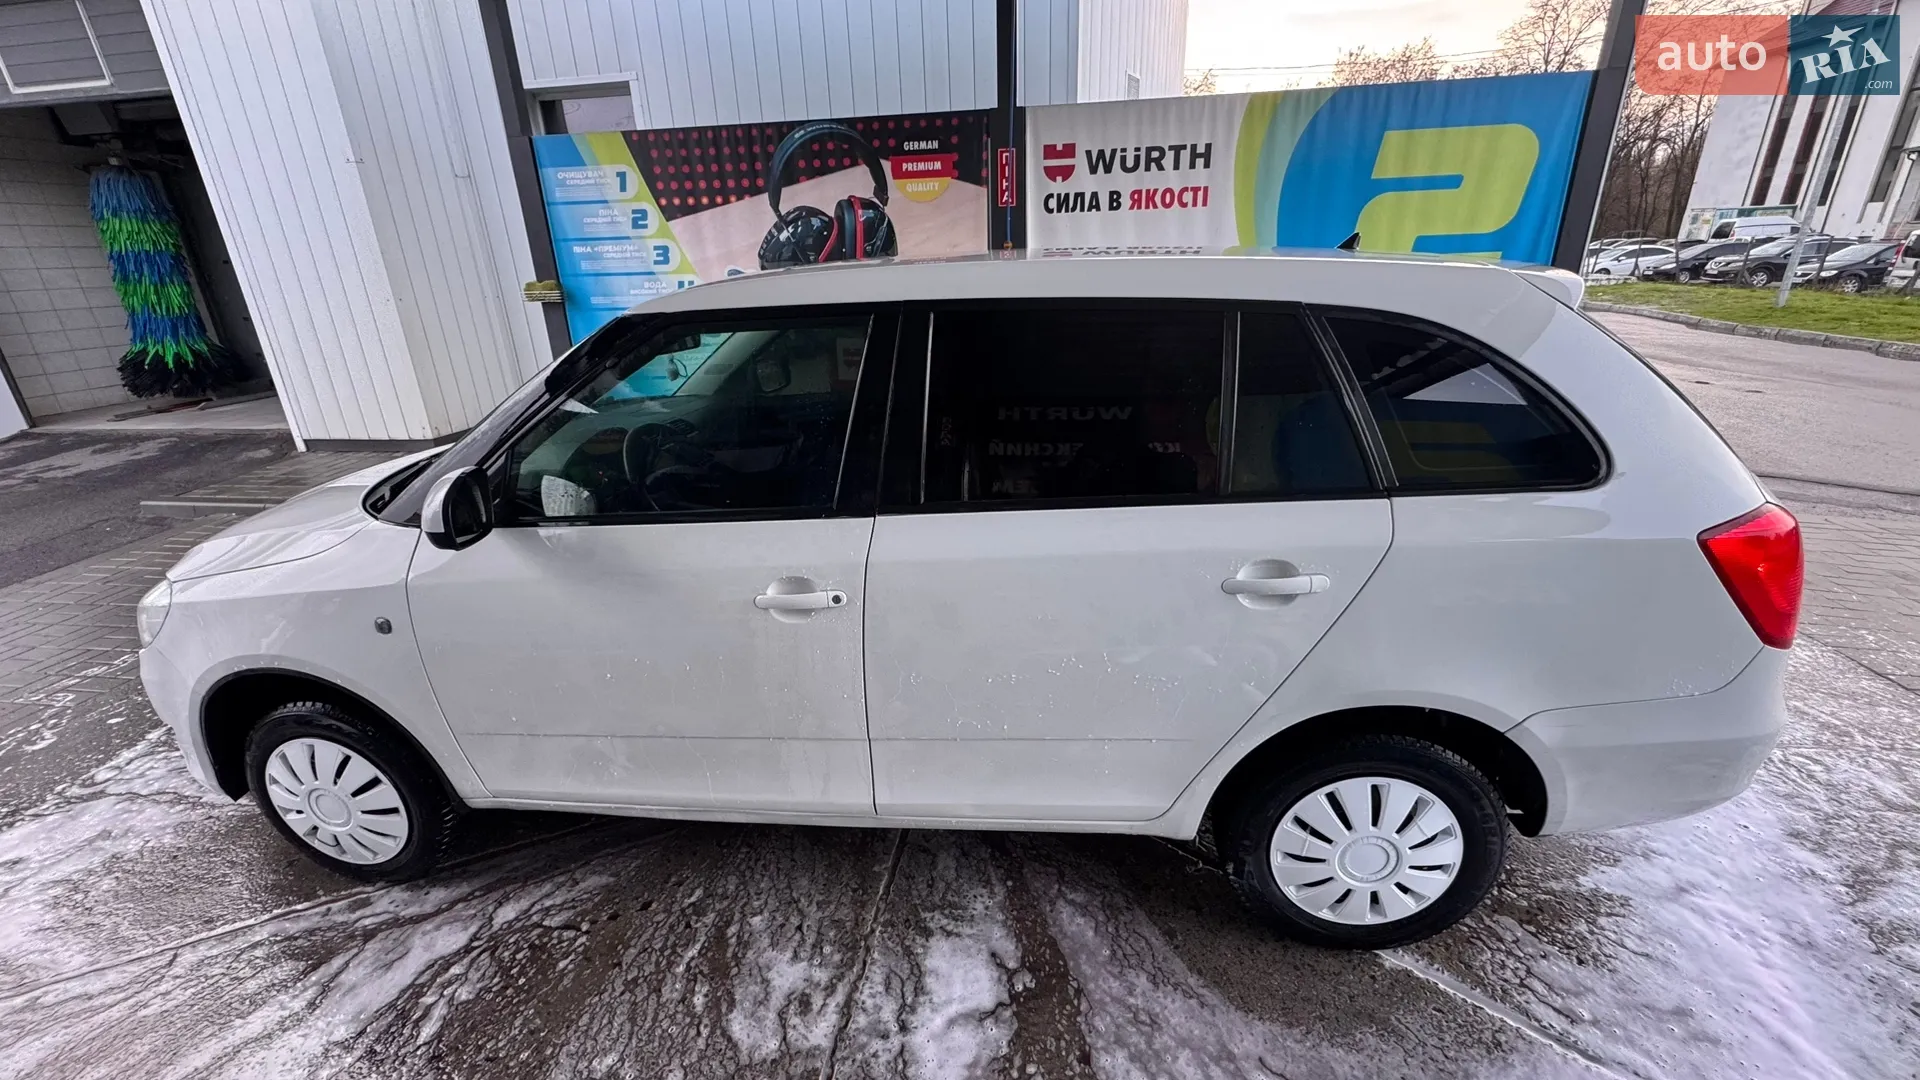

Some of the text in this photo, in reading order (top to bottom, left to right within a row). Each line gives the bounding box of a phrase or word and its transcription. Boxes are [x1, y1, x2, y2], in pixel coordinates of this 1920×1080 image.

[903, 140, 939, 151] GERMAN
[902, 161, 942, 172] PREMIUM
[1085, 143, 1213, 176] WÜRTH
[615, 171, 627, 192] 1
[906, 182, 940, 192] QUALITY
[1355, 123, 1540, 258] 2
[1042, 186, 1209, 214] СИЛА В ЯКОСТІ
[599, 208, 619, 216] ПІНА
[631, 208, 649, 230] 2
[653, 245, 671, 266] 3
[643, 281, 667, 289] ВОДА
